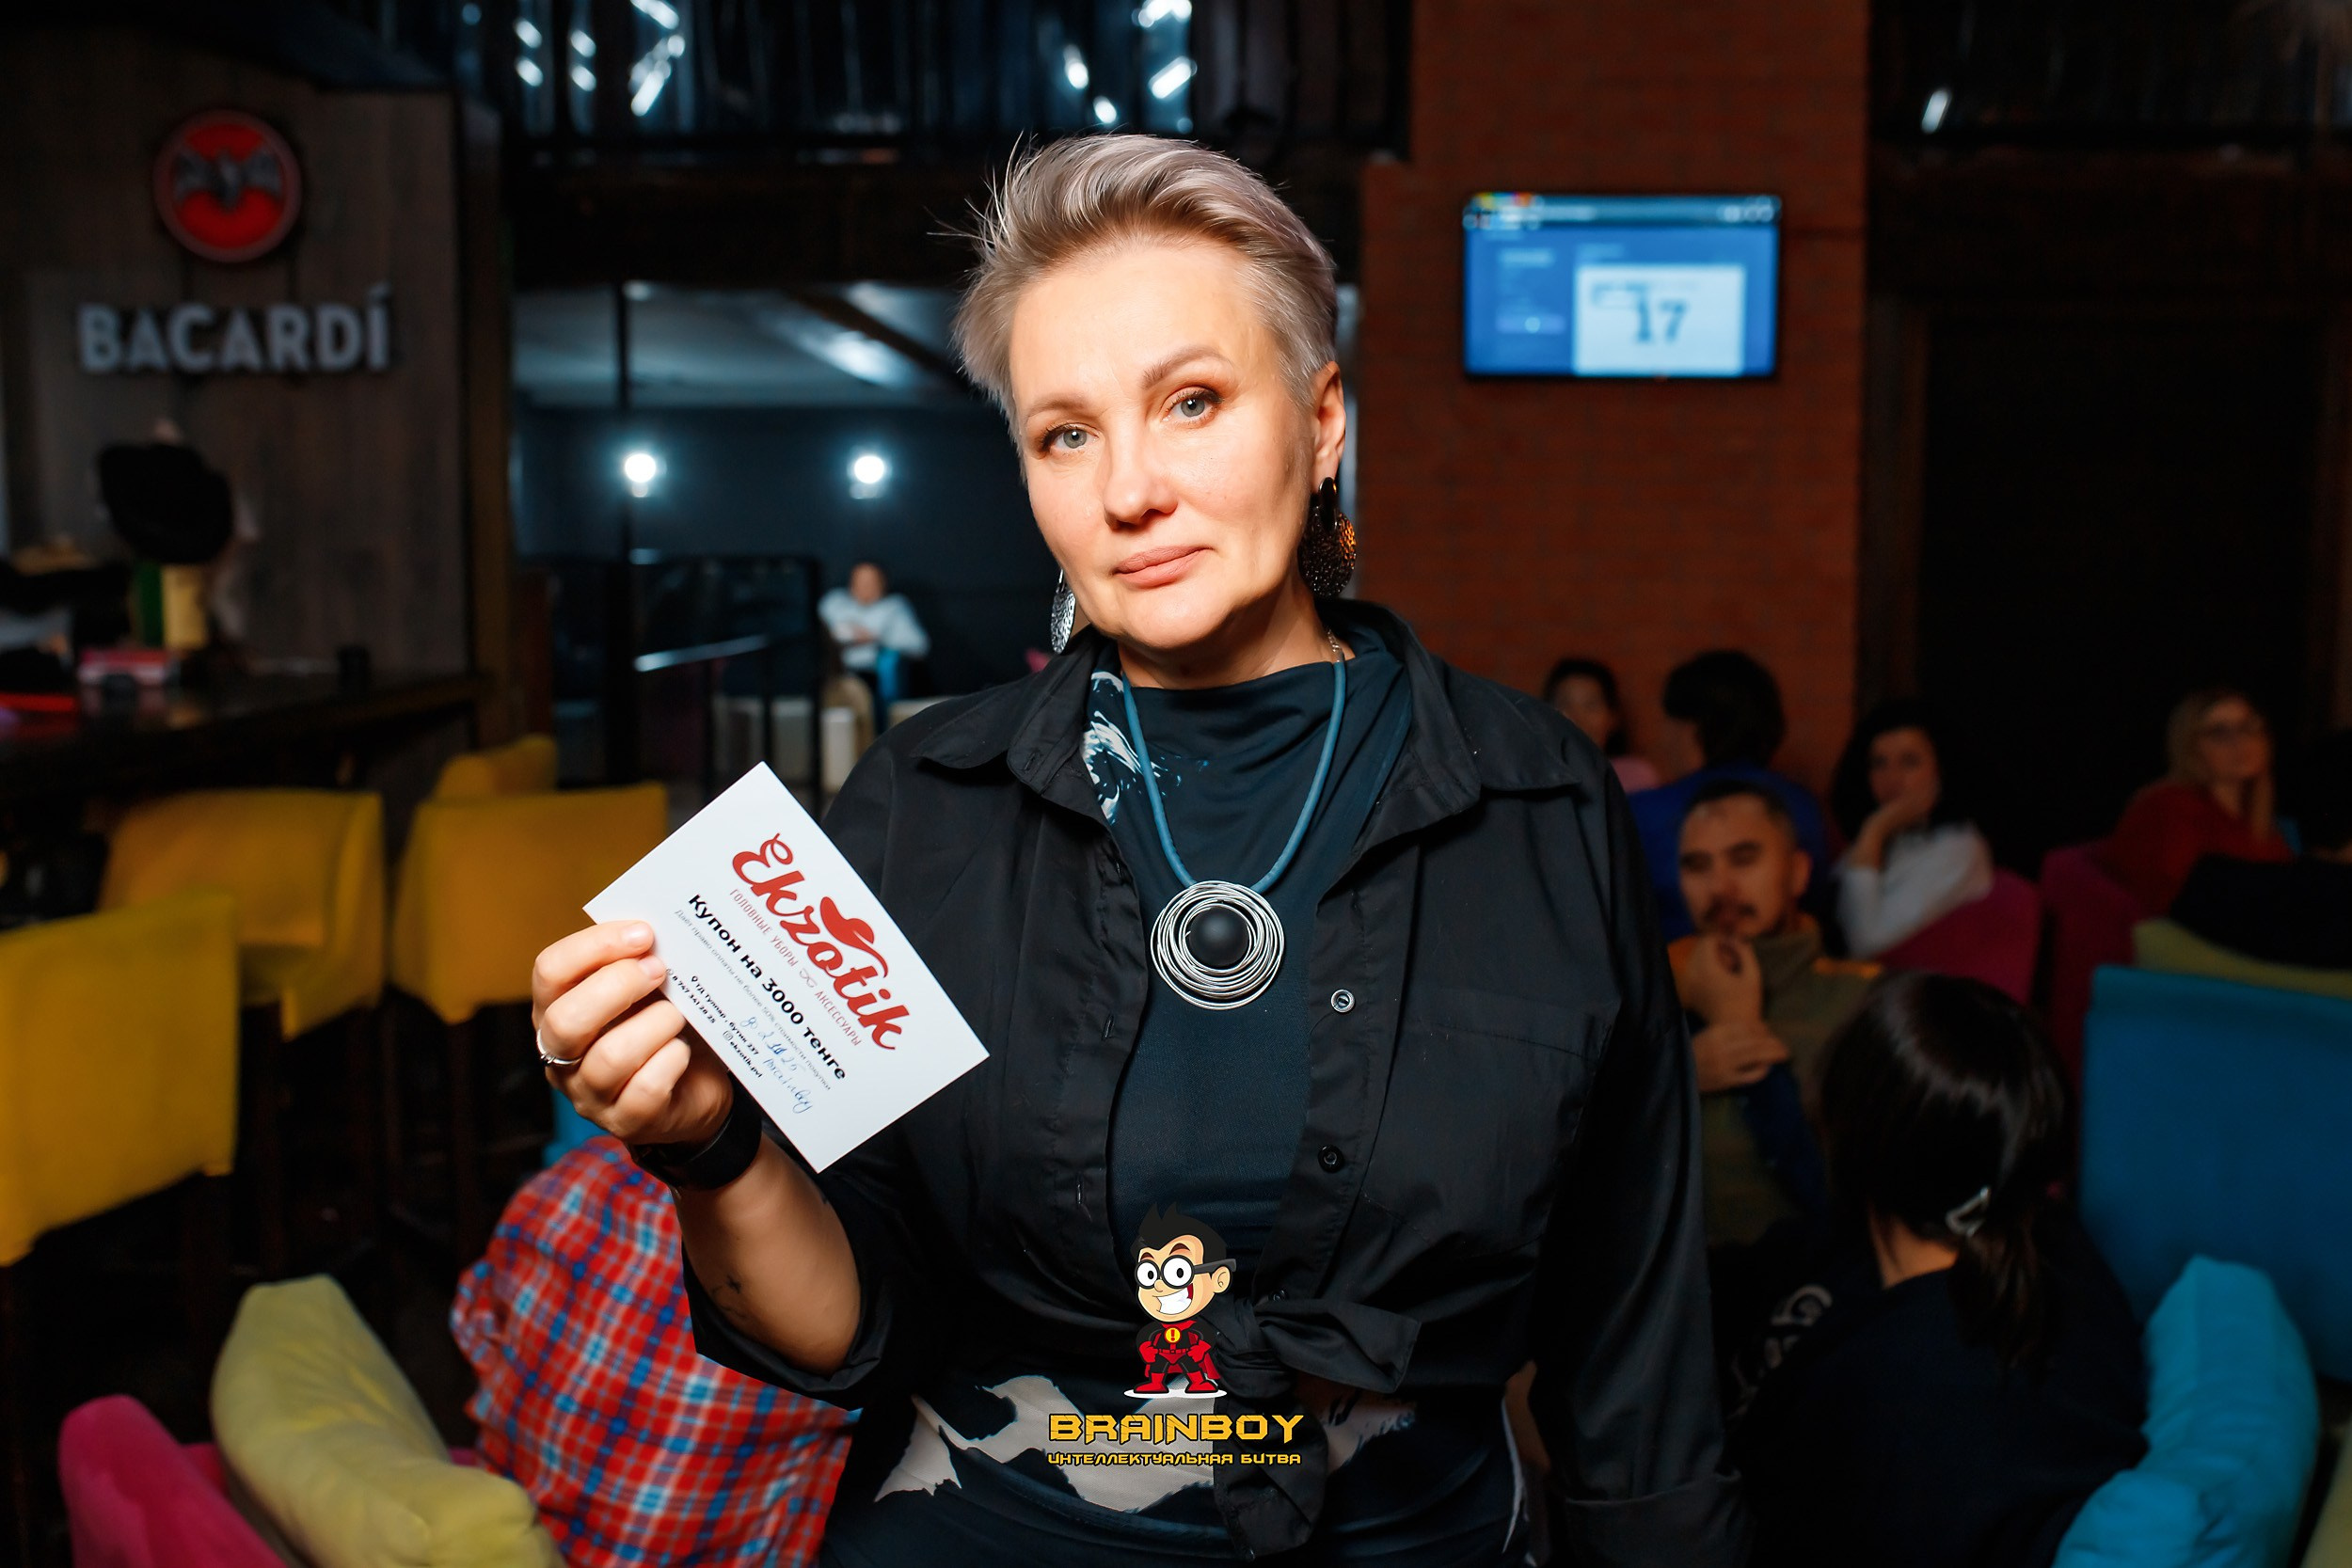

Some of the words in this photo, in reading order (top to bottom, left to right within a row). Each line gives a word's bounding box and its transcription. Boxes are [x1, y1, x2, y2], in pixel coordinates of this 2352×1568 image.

[78, 284, 390, 373] BACARDÍ
[688, 894, 740, 953] Купон
[739, 954, 762, 978] на
[761, 977, 803, 1024] 3000
[803, 1026, 845, 1079] тенге
[729, 889, 771, 933] ГОЛОВНЫЕ
[770, 935, 798, 966] УБОРЫ
[814, 990, 861, 1046] АКСЕССУАРЫ
[732, 832, 910, 1050] Ekzotik
[734, 974, 743, 984] не
[742, 985, 762, 1006] более
[804, 1059, 831, 1090] покупки
